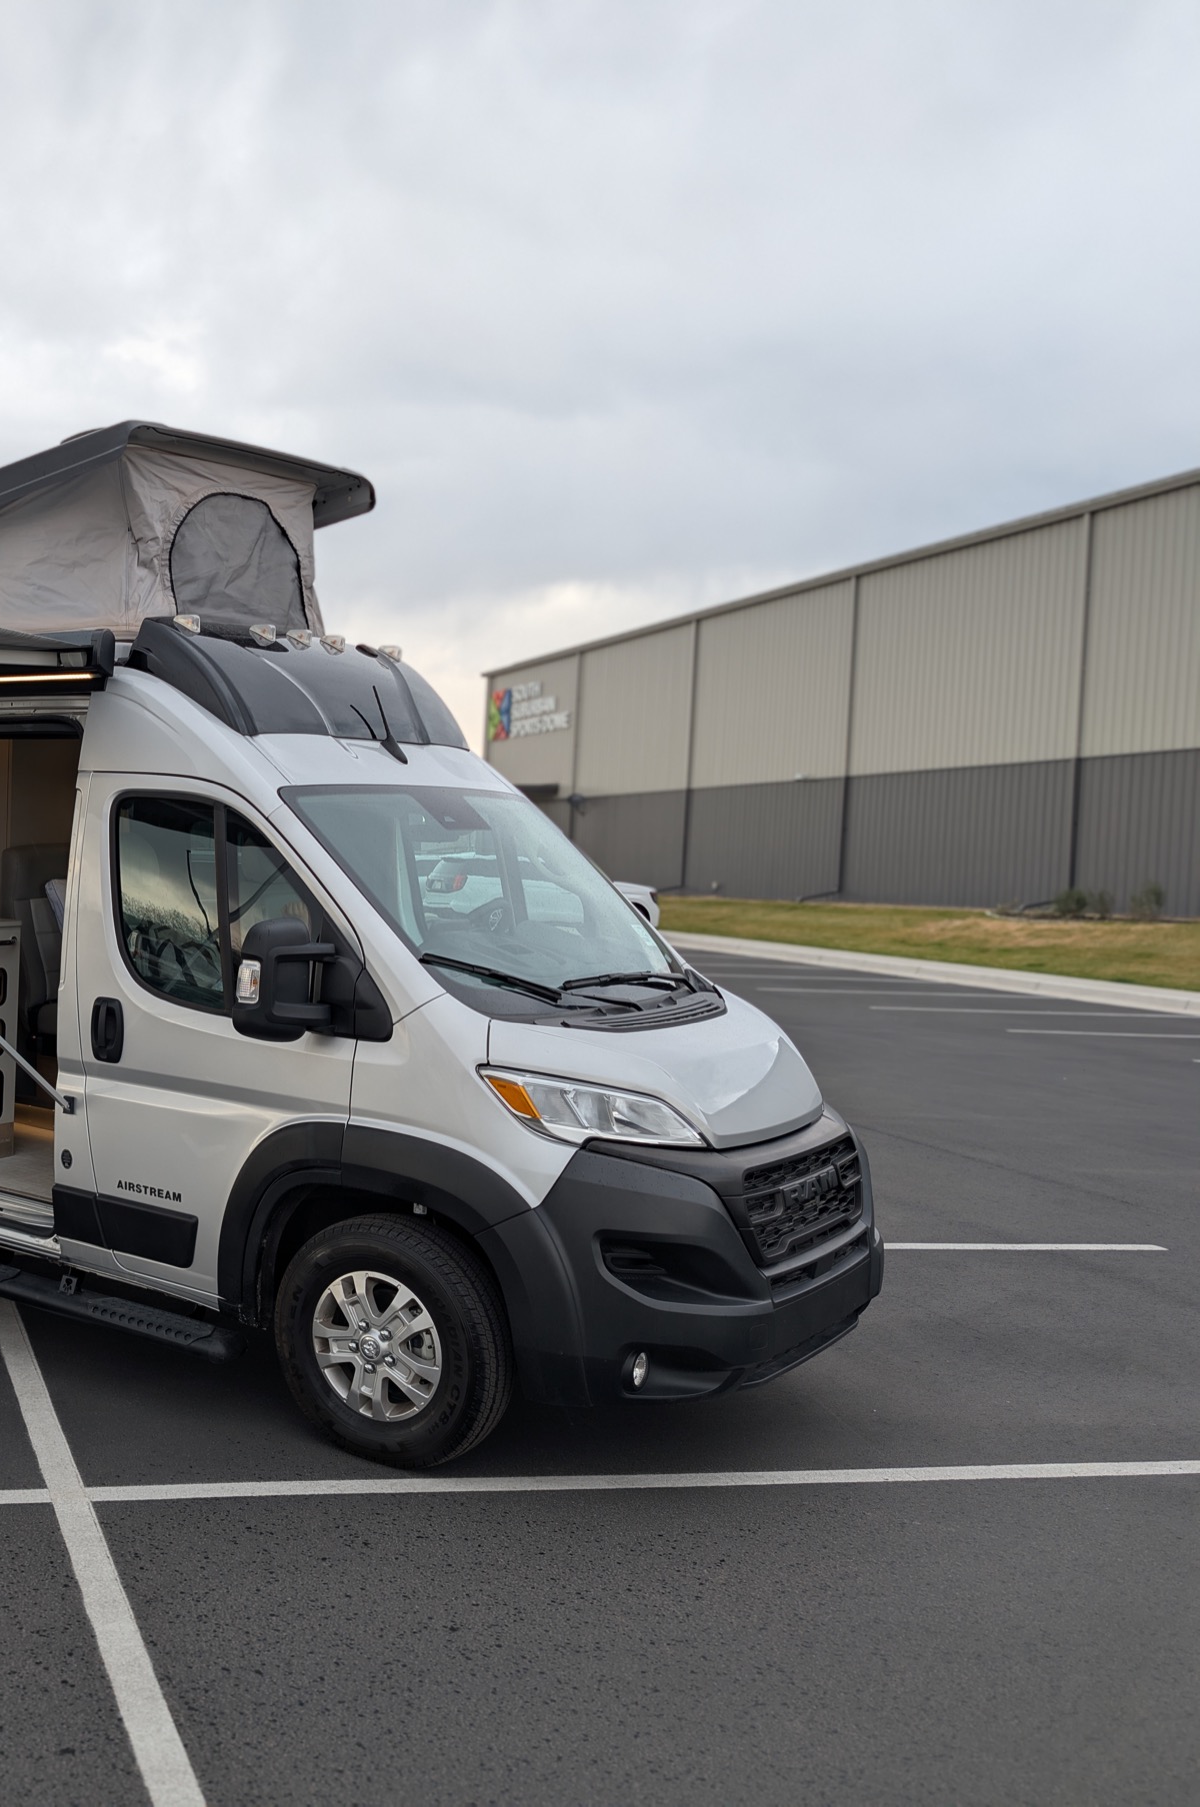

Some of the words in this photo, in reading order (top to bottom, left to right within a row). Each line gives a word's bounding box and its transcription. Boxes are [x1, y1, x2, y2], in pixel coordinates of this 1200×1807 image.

[512, 681, 541, 702] SOUTH
[512, 696, 556, 719] SUBURBAN
[117, 1180, 182, 1202] AIRSTREAM
[784, 1168, 838, 1207] RAM
